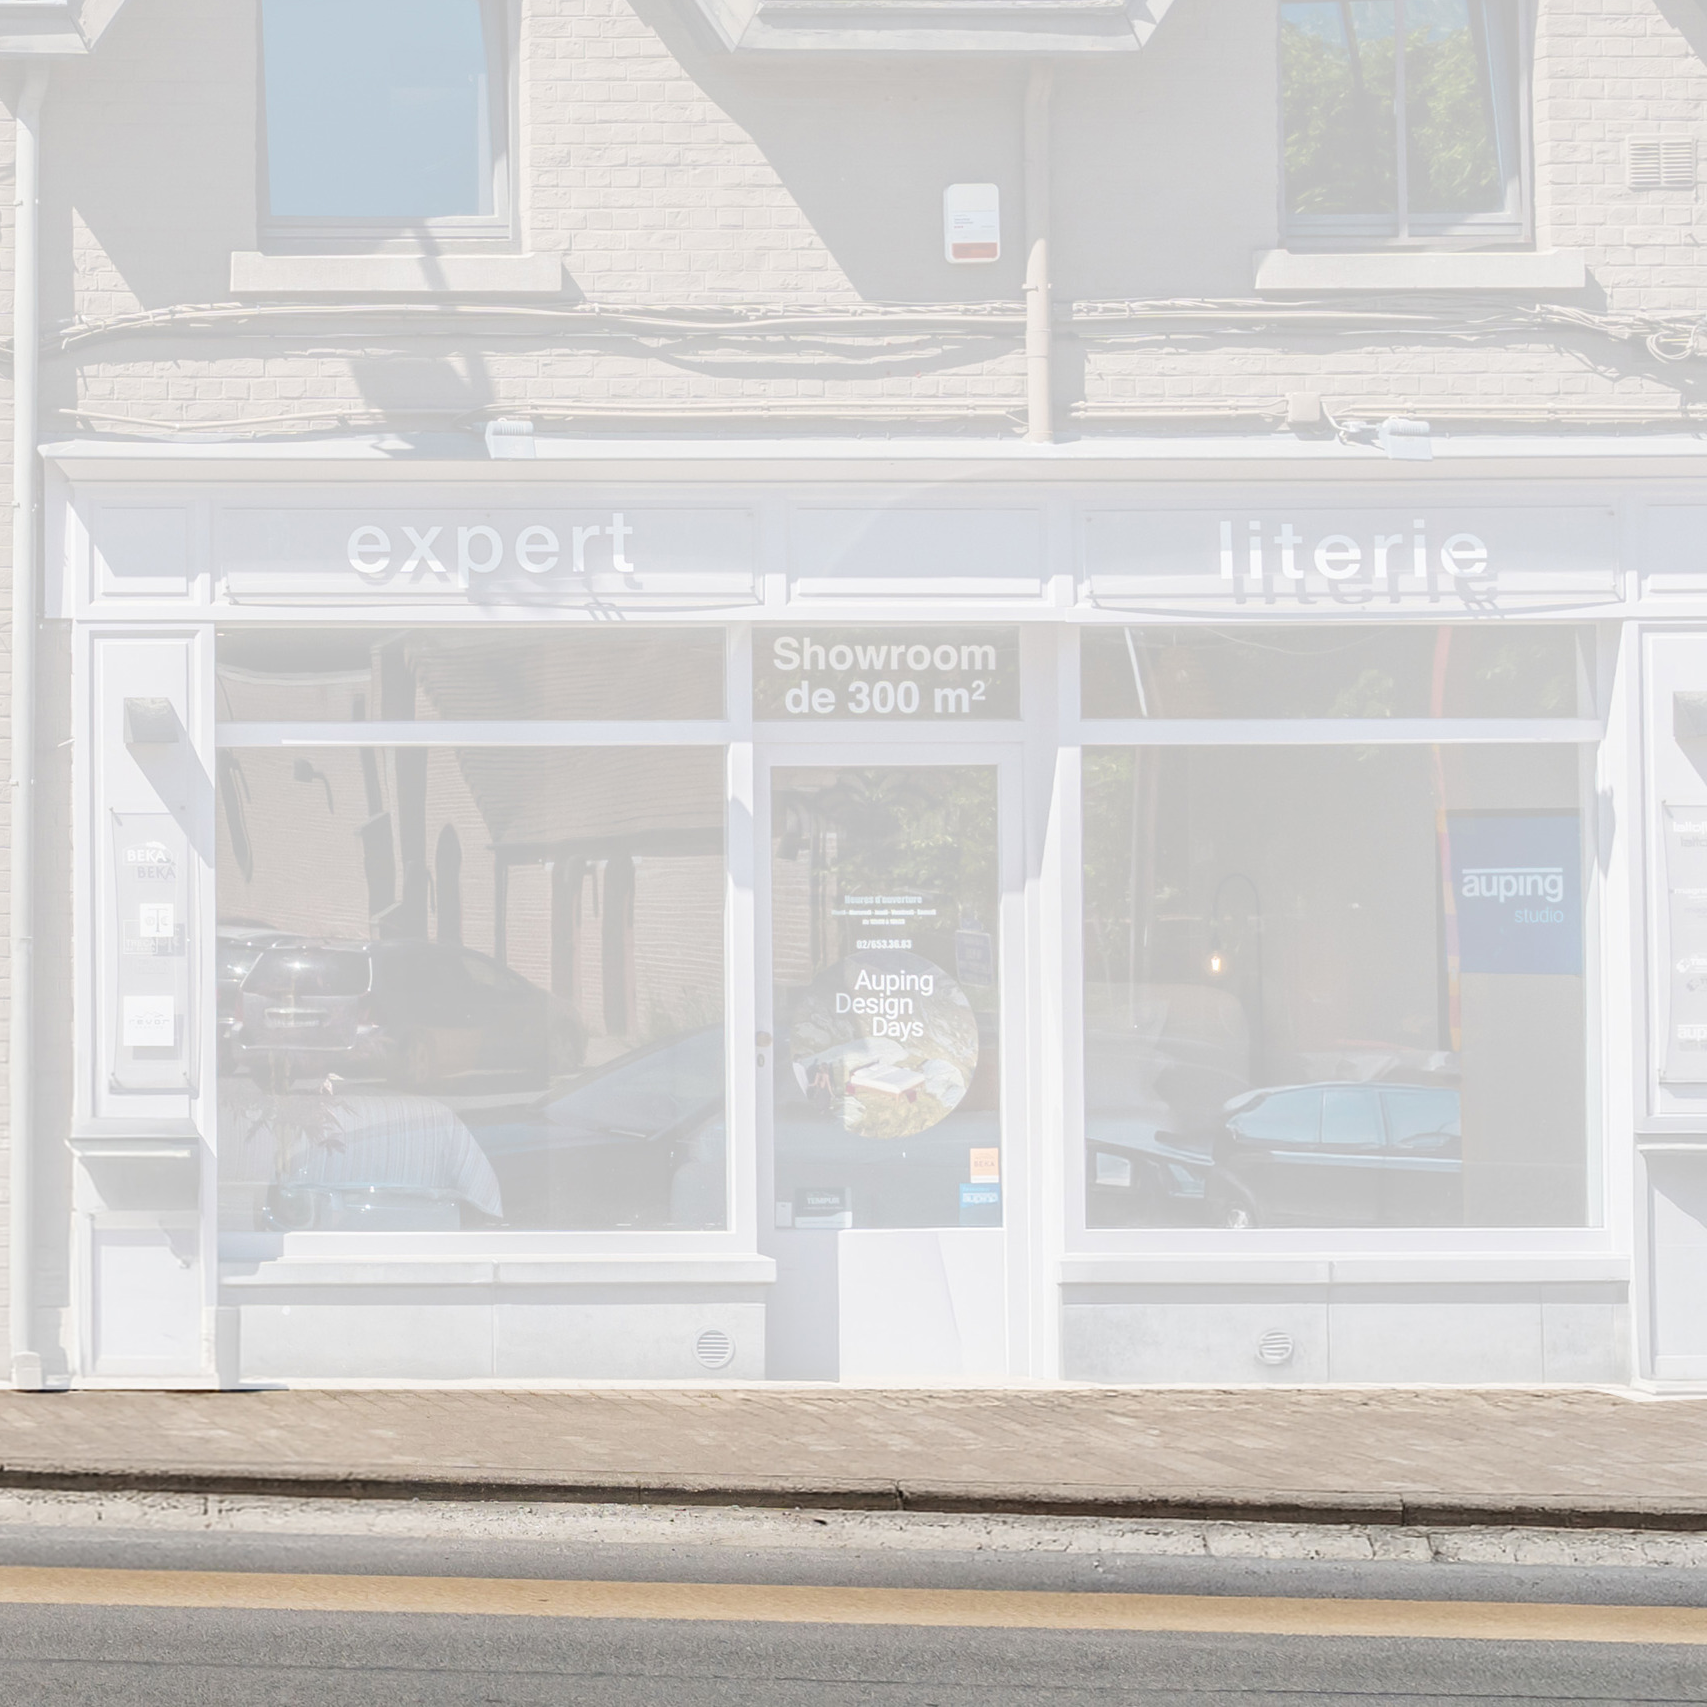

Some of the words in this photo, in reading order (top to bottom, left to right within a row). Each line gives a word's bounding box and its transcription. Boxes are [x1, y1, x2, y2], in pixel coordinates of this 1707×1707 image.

[347, 512, 634, 588] expert
[1219, 518, 1488, 579] literie
[773, 636, 996, 671] Showroom
[785, 680, 836, 714] de
[848, 680, 920, 714] 300
[127, 849, 167, 862] BEKA
[844, 895, 874, 904] Heures
[1461, 873, 1564, 903] auping
[1514, 906, 1564, 924] studio
[854, 969, 934, 996] Auping
[836, 993, 913, 1020] Design
[873, 1016, 924, 1042] Days
[807, 1197, 840, 1205] TEMPUR
